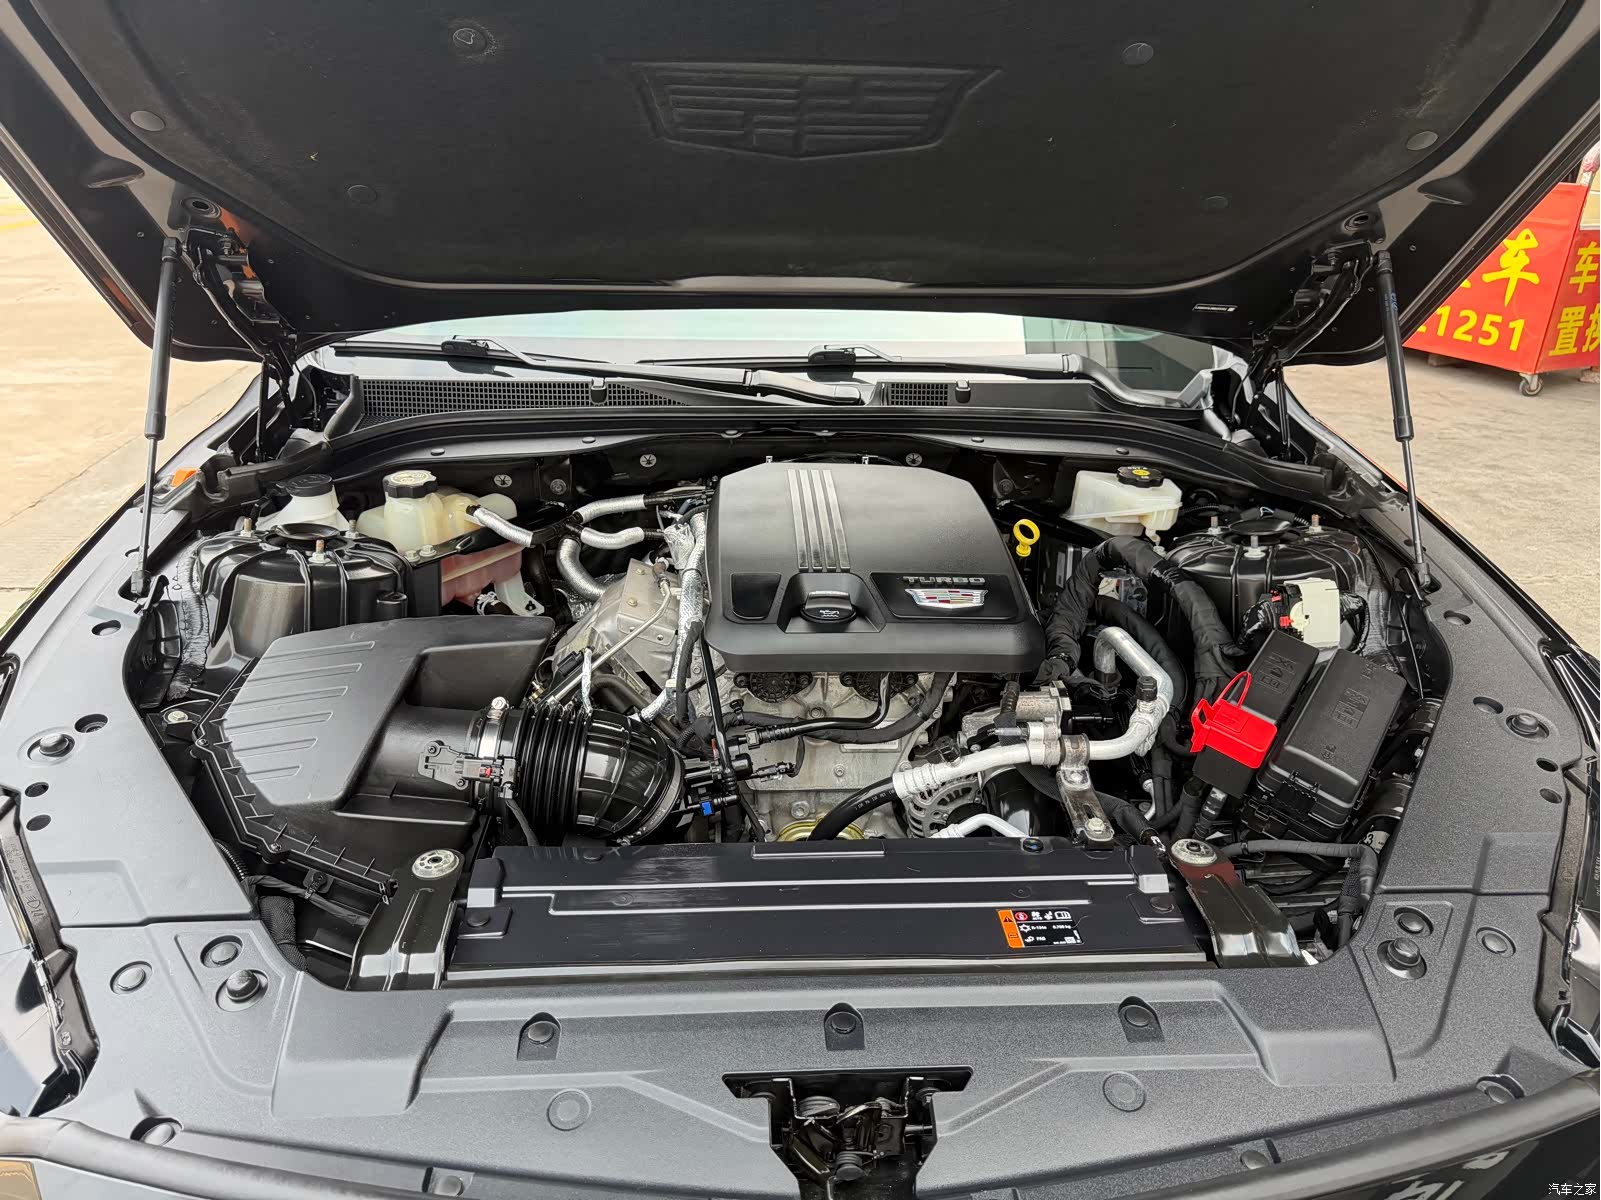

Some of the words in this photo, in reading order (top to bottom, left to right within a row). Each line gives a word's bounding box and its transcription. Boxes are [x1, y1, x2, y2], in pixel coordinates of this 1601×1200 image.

[1460, 228, 1539, 307] 车
[1569, 241, 1600, 294] 车
[1417, 305, 1525, 352] 1251
[903, 576, 985, 585] TURBO
